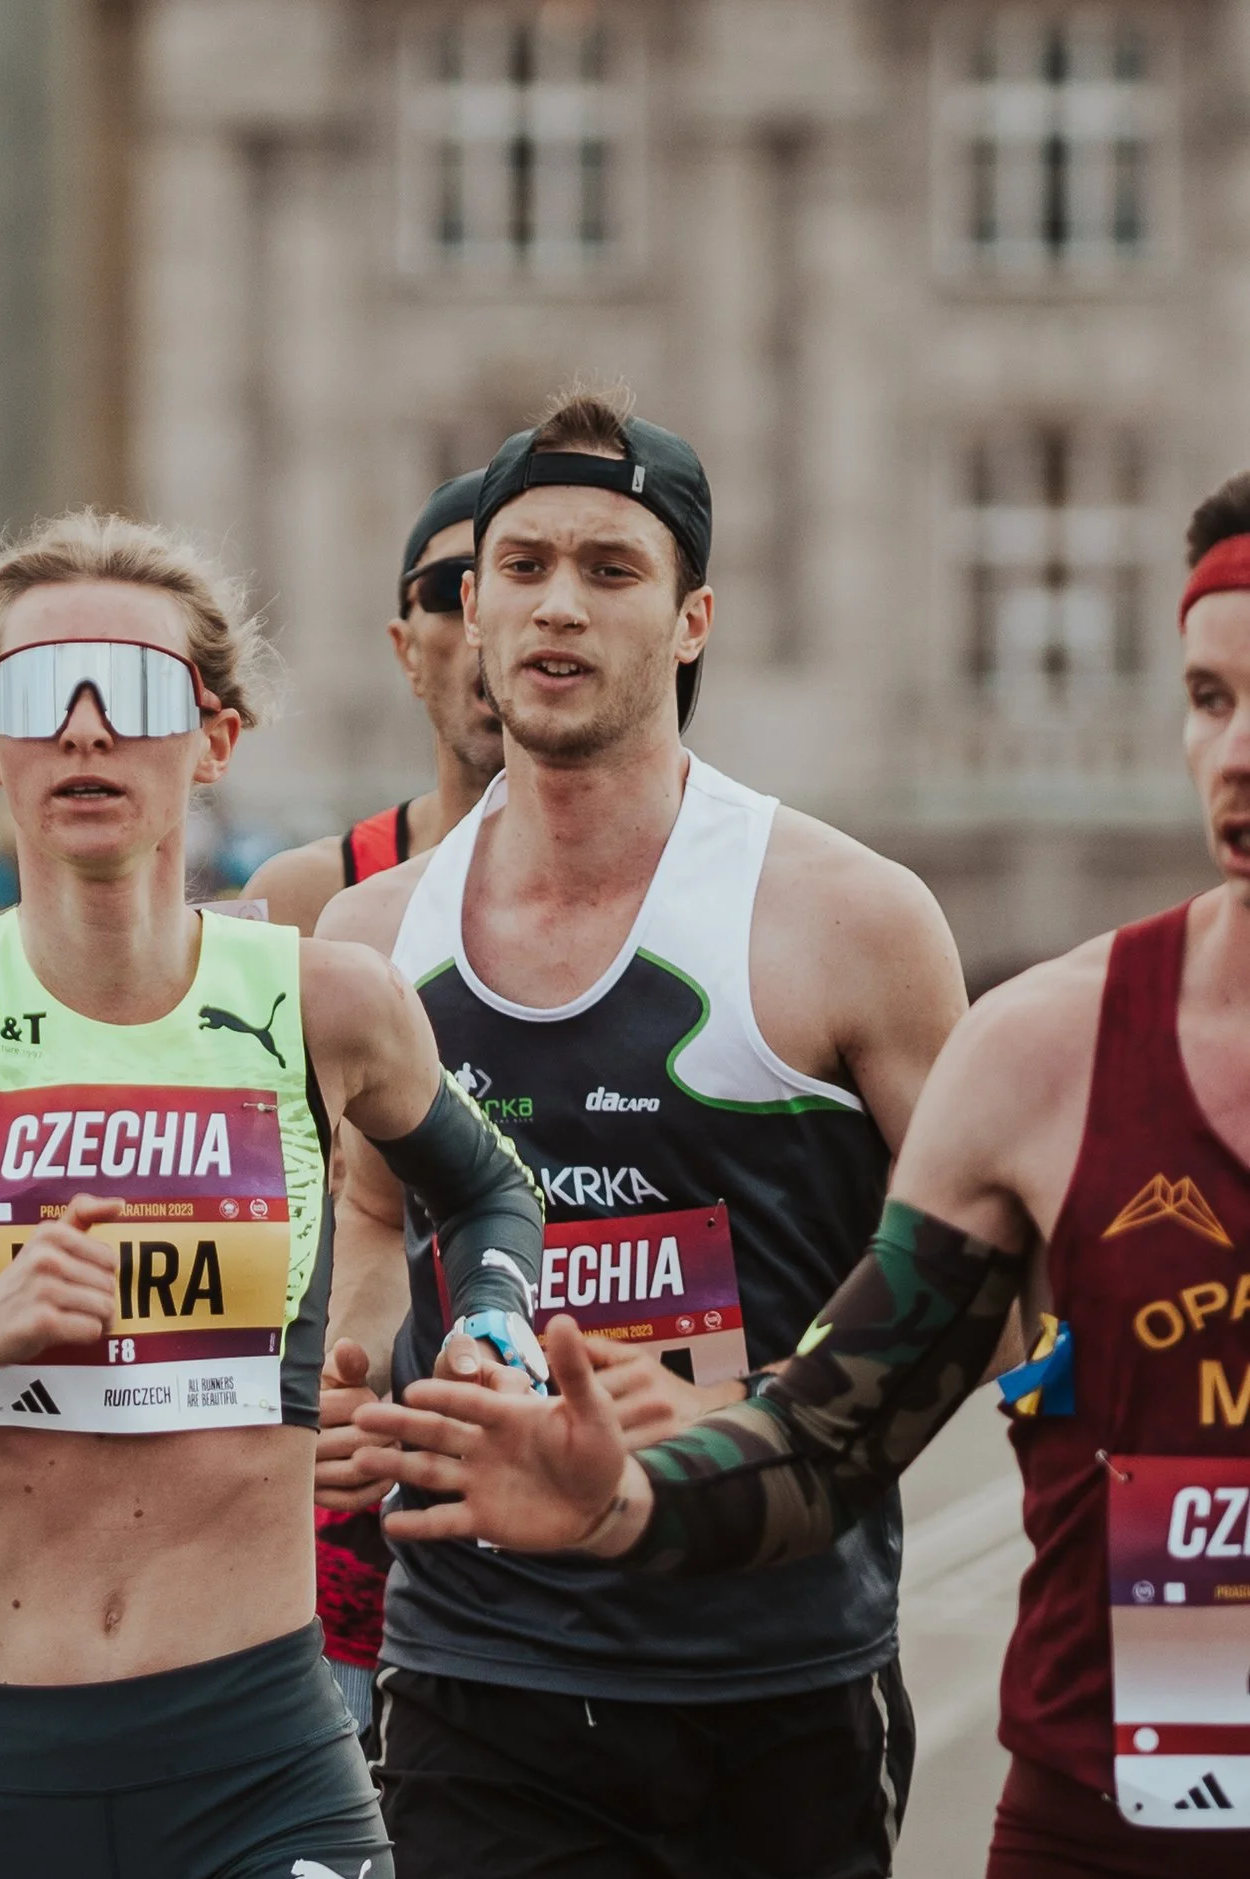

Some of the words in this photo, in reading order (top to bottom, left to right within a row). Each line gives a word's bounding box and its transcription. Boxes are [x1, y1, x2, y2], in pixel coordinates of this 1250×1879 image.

[479, 1097, 533, 1117] rka
[0, 1110, 232, 1180] CZECHIA
[540, 1166, 670, 1207] KRKA
[40, 1204, 68, 1219] PRAG
[118, 1203, 167, 1217] ARATHON
[168, 1203, 193, 1217] 2023
[11, 1241, 226, 1320] IRA
[535, 1236, 685, 1310] ECHIA
[630, 1323, 654, 1338] 2023
[108, 1338, 136, 1363] F8
[188, 1378, 199, 1393] ALL
[201, 1376, 235, 1391] RUNNERS
[103, 1386, 172, 1407] RUNCZECH
[186, 1394, 200, 1408] ARE
[201, 1392, 238, 1407] BEAUTIFUL
[1167, 1486, 1250, 1559] CZ
